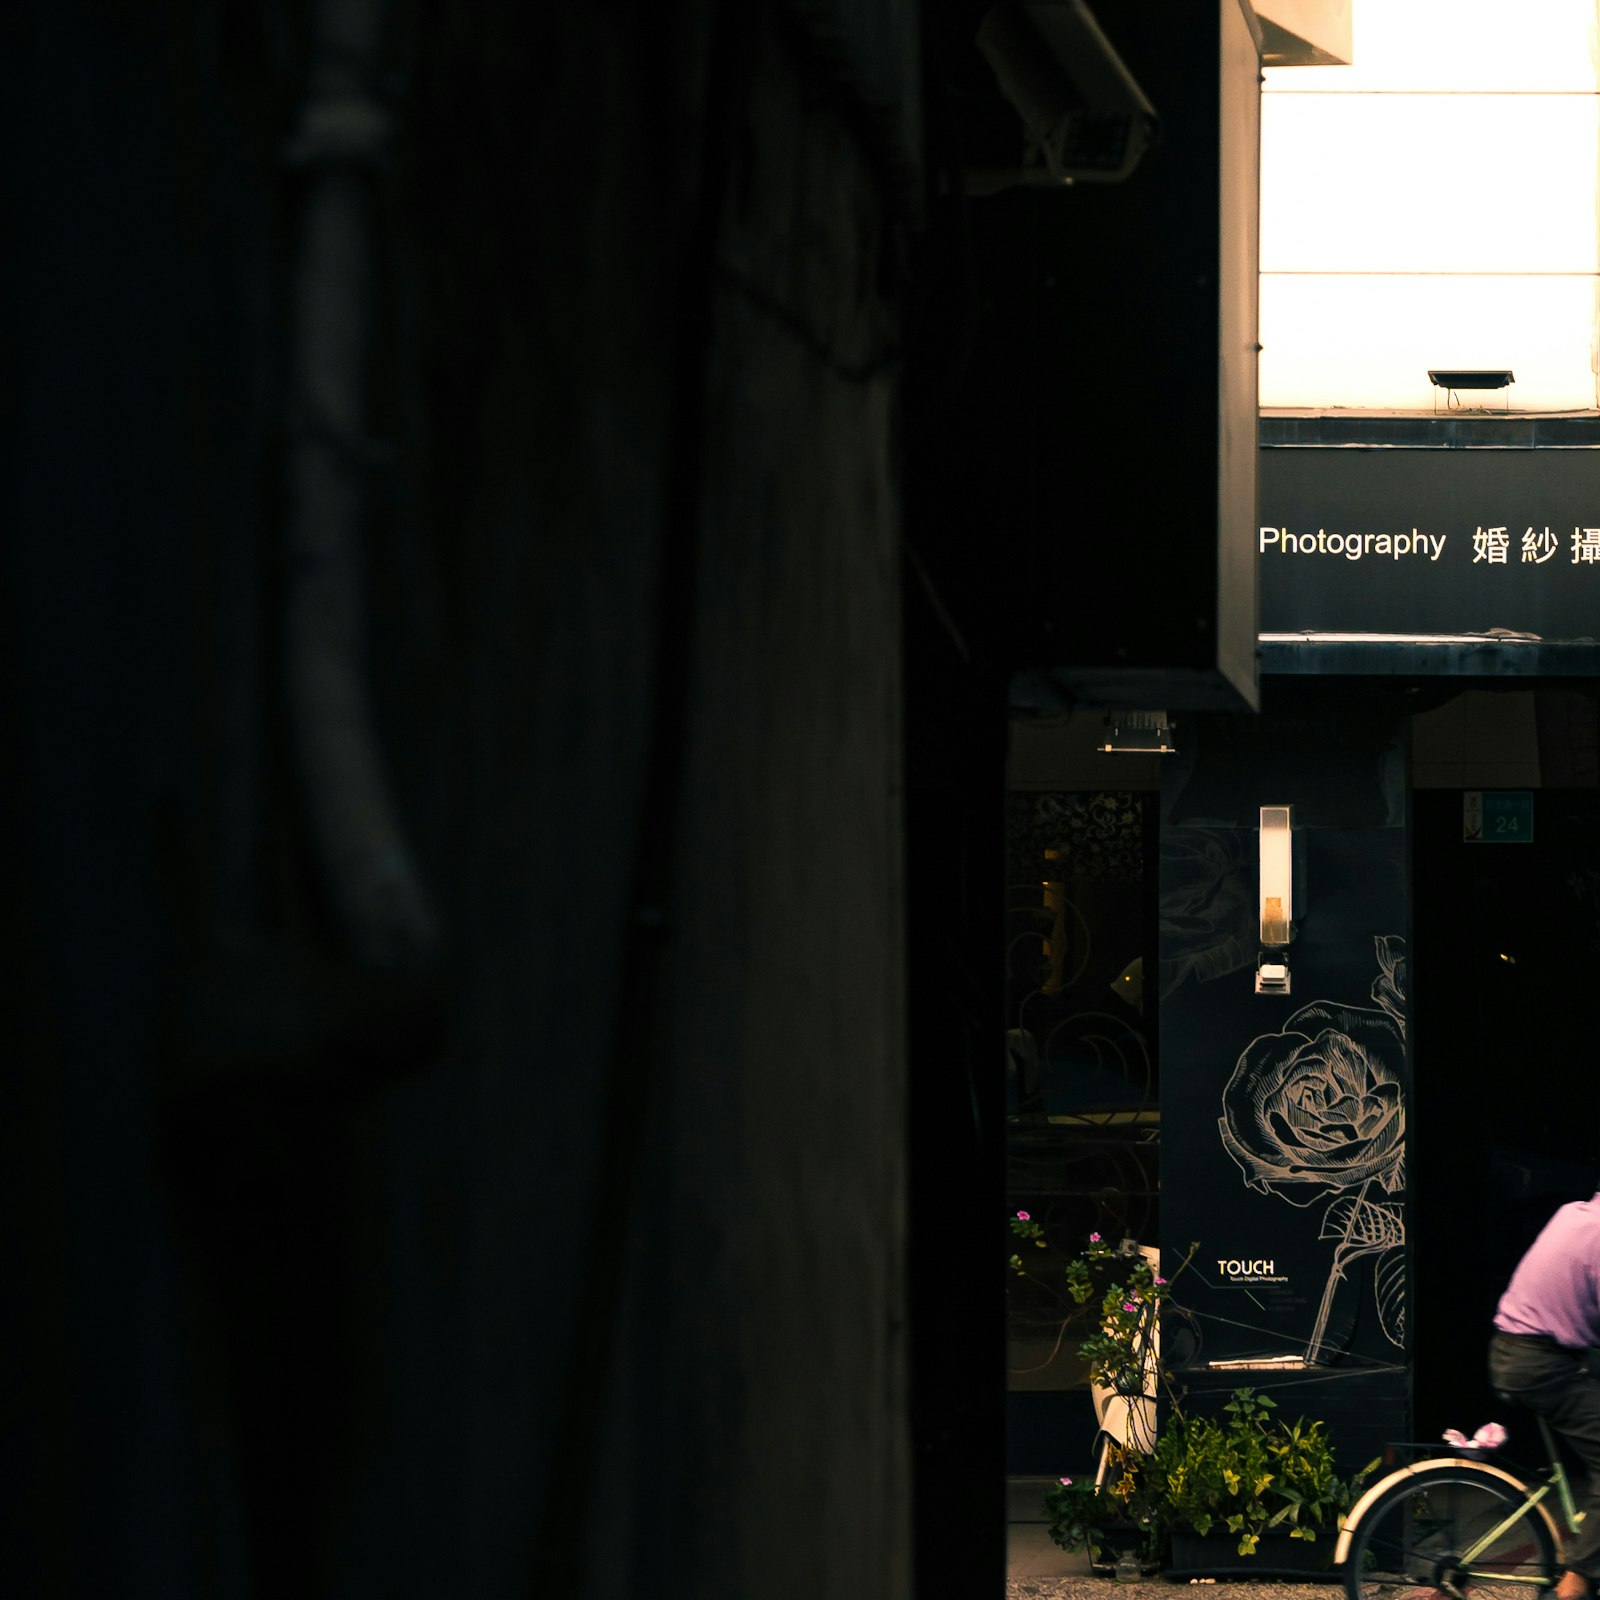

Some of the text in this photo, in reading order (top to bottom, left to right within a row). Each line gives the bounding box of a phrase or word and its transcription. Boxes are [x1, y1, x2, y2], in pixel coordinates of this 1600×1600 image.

[1259, 526, 1446, 561] Photography
[1496, 816, 1519, 833] 24
[1217, 1259, 1275, 1275] TOUCH
